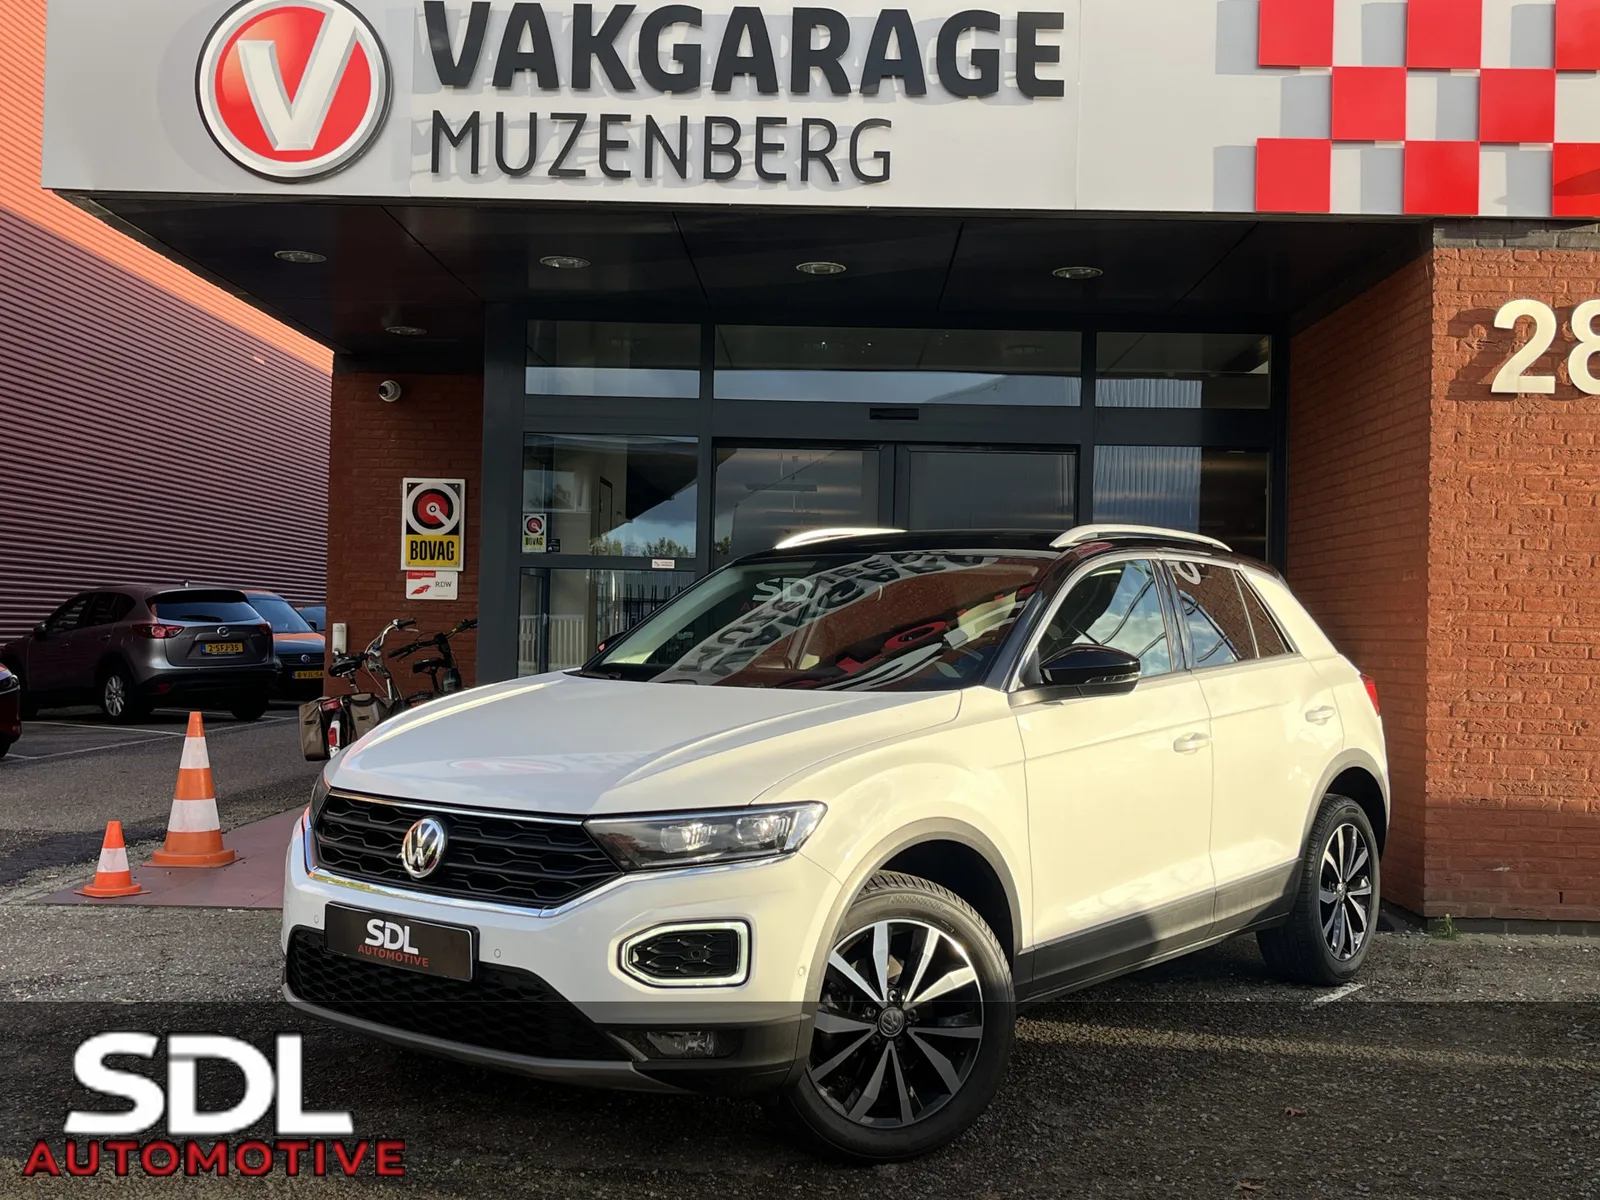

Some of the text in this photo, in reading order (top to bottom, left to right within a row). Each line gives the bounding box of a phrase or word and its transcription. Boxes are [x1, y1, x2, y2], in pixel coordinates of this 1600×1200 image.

[423, 0, 1064, 99] VAKGARAGE
[431, 109, 892, 183] MUZENBERG
[410, 540, 455, 561] BOVAG
[365, 918, 419, 955] SDL
[358, 944, 429, 968] AUTOMOTIVE
